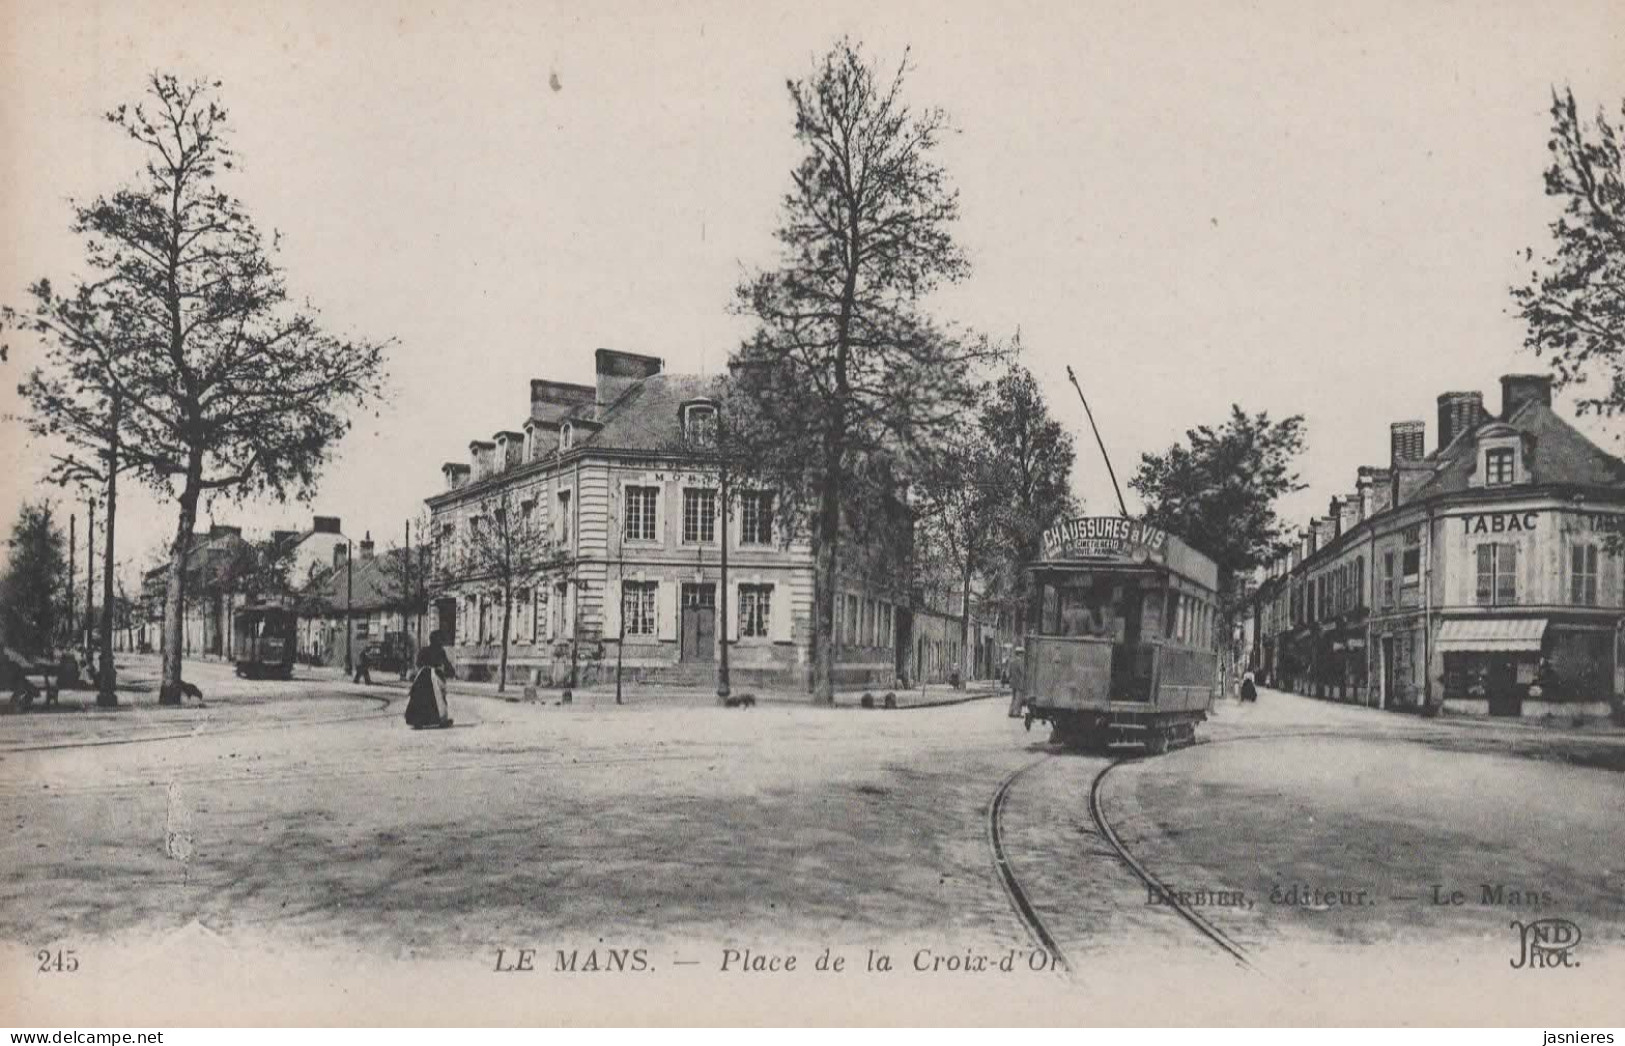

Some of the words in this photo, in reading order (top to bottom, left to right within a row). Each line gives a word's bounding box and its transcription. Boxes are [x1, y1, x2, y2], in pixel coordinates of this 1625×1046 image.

[1043, 518, 1130, 549] CHAUSSURES
[1141, 524, 1166, 549] VIS
[1460, 512, 1539, 534] TABAC
